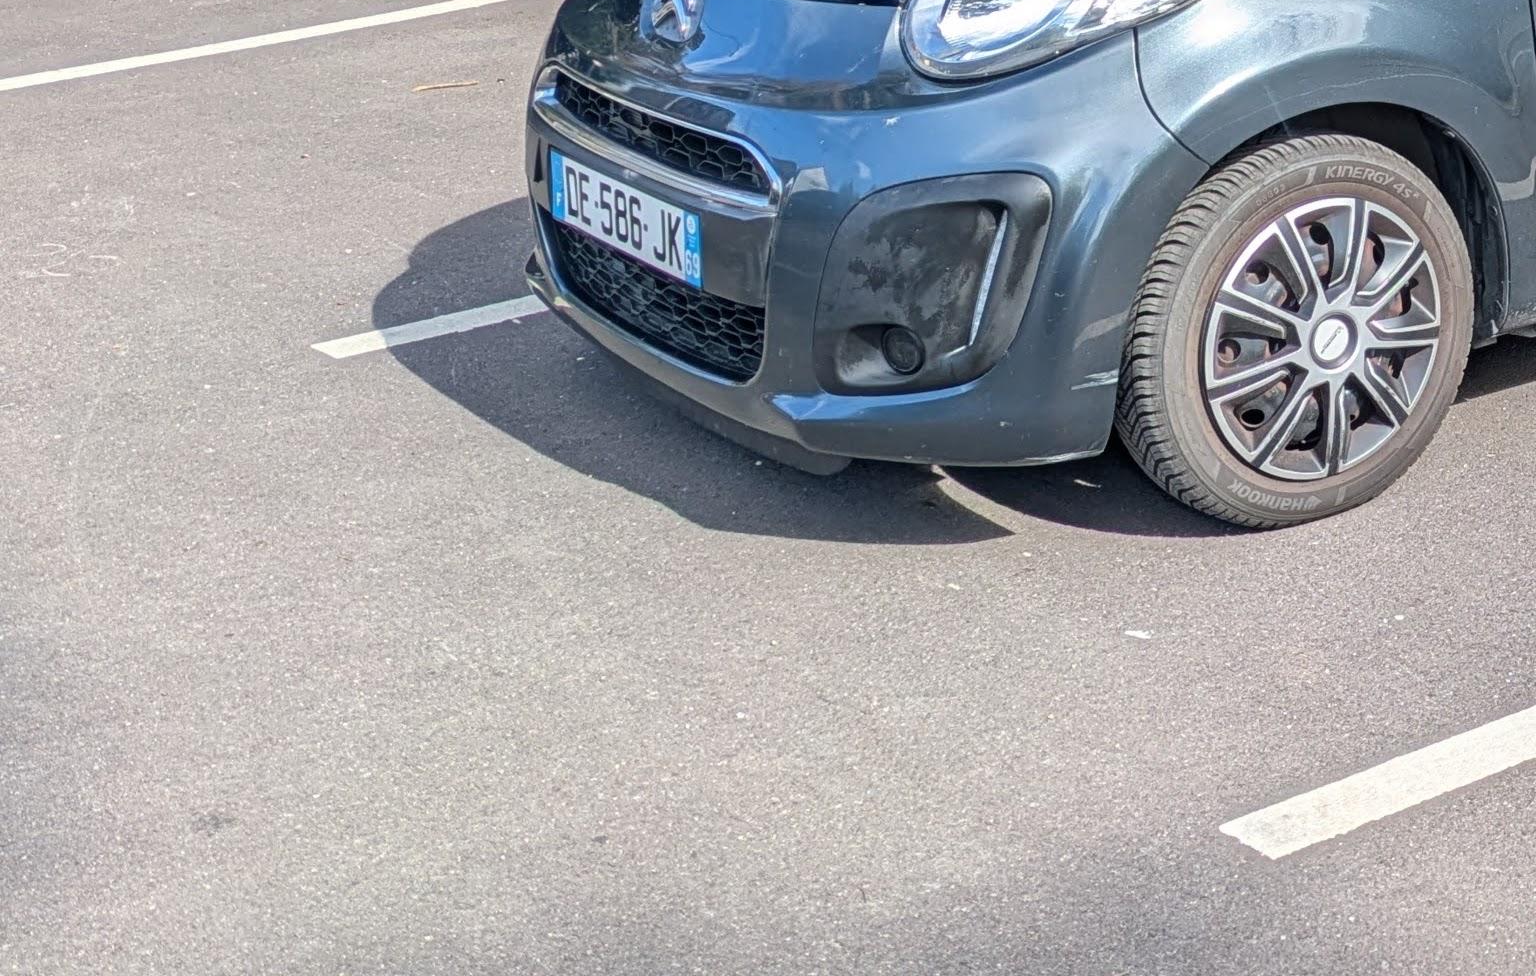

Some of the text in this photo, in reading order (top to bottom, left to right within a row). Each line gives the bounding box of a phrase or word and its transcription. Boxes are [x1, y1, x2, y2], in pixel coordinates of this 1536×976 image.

[1325, 165, 1395, 184] KINERGY
[556, 191, 563, 207] F
[686, 249, 700, 279] 69
